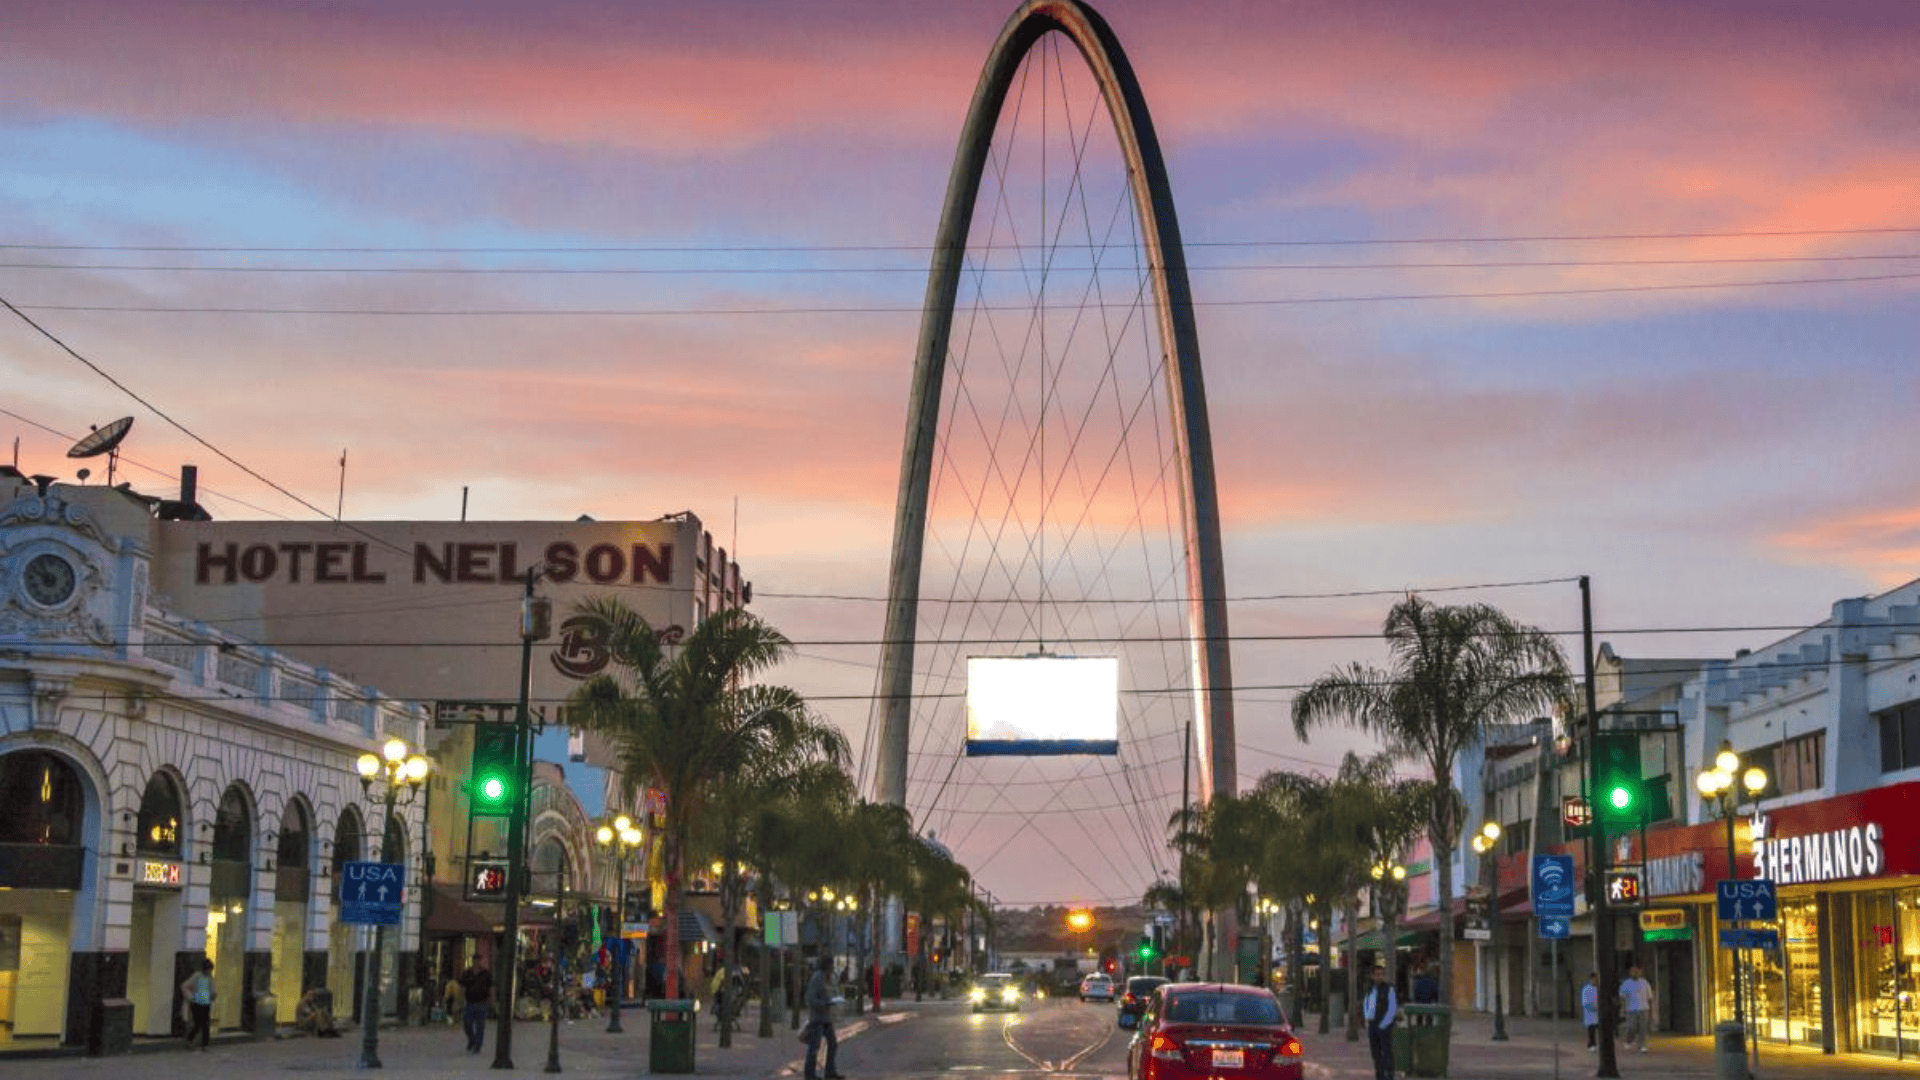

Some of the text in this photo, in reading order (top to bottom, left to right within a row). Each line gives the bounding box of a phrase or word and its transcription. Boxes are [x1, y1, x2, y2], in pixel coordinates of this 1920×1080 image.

[196, 541, 674, 585] HOTEL NELSON
[1767, 822, 1880, 885] HERMANOS
[349, 866, 397, 883] USA
[1623, 879, 1638, 898] 21
[1723, 883, 1771, 899] USA
